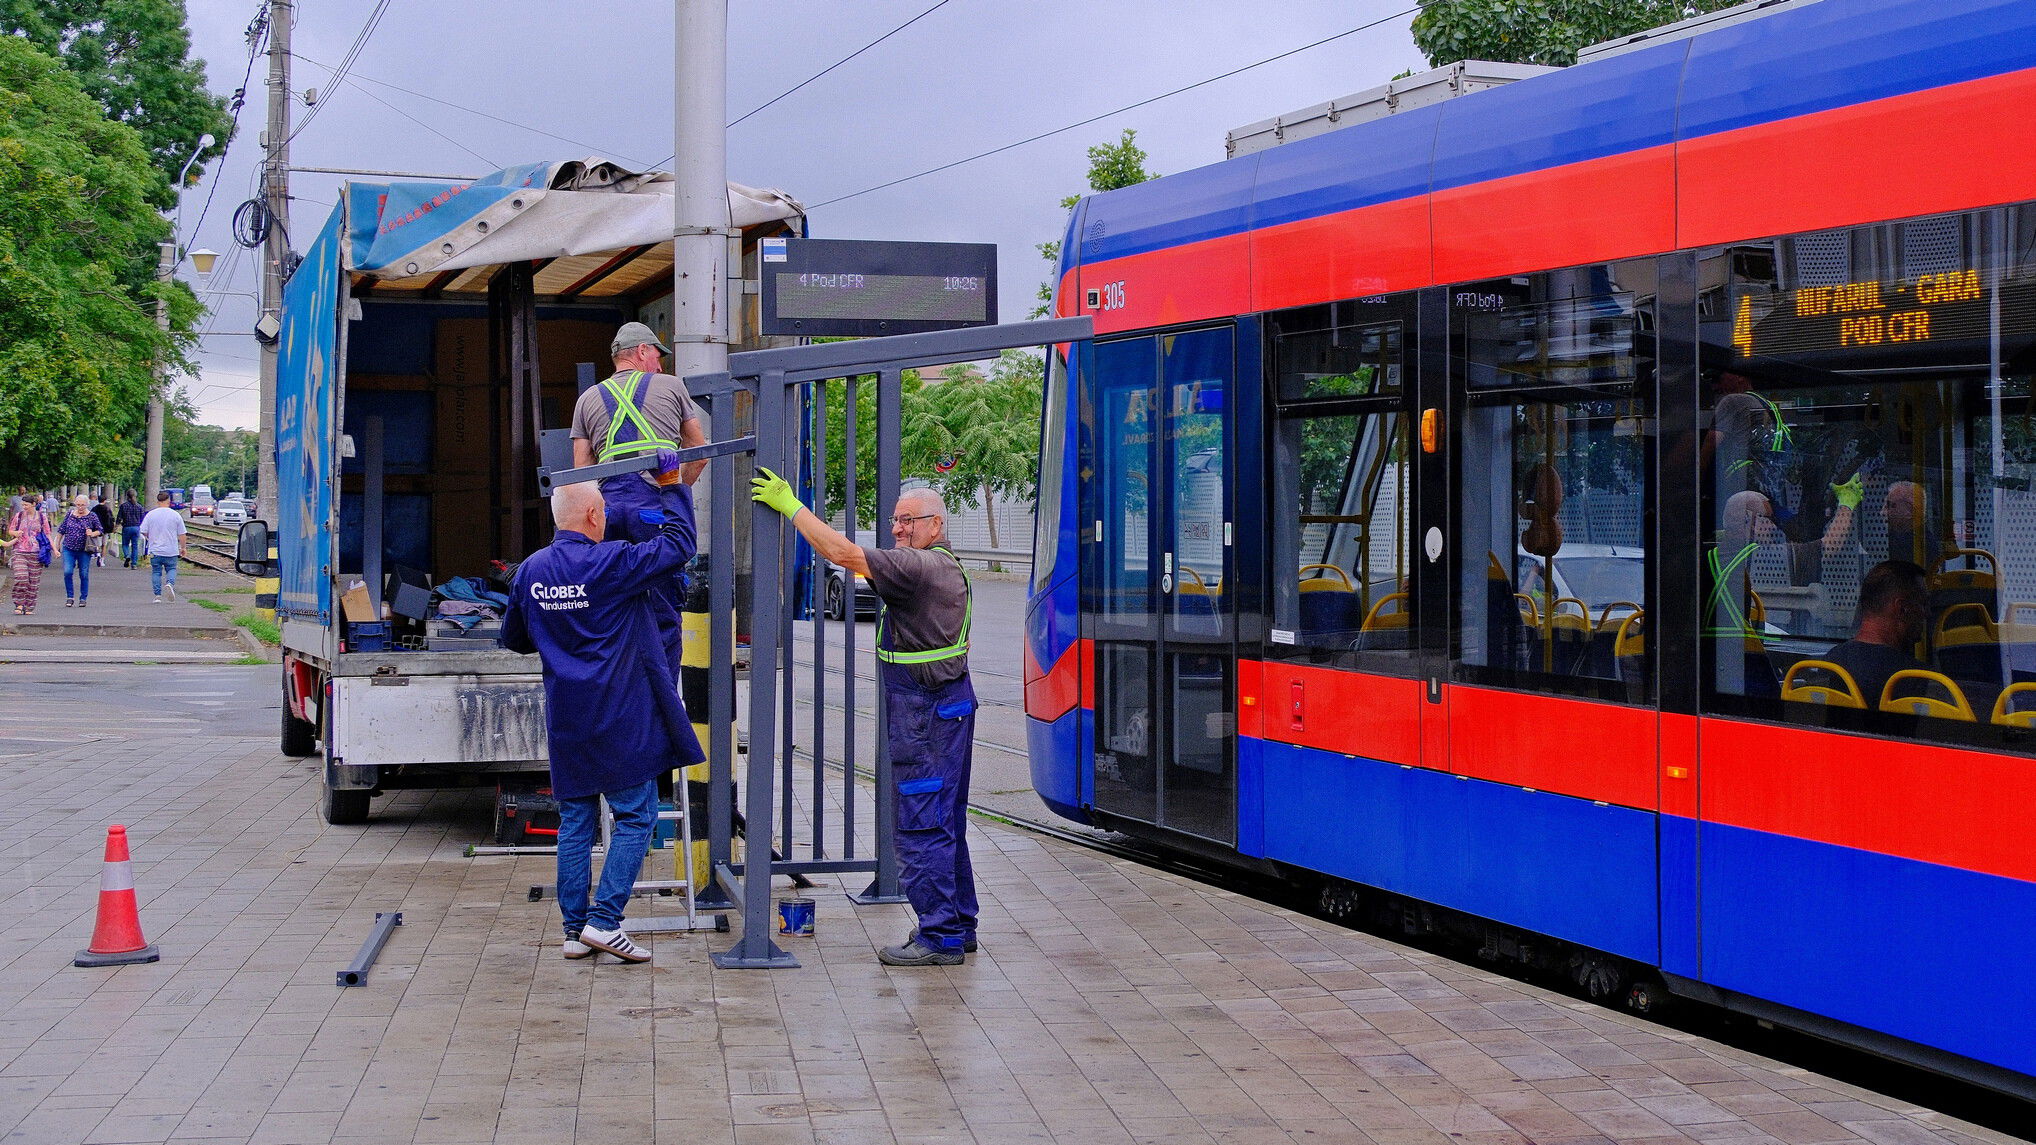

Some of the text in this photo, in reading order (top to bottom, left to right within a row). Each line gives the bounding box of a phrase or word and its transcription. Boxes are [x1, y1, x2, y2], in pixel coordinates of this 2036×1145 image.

[799, 274, 864, 288] 4 Pod CFR
[944, 276, 977, 290] 10:26
[1104, 280, 1125, 311] 305
[1797, 280, 1886, 317] NUFARUL
[1916, 269, 1981, 304] GARA
[1733, 295, 1751, 357] 4
[1841, 310, 1931, 346] POD CFR
[453, 335, 467, 443] www.jaolar.com
[530, 582, 588, 600] GLOBEX
[545, 599, 590, 611] Industries
